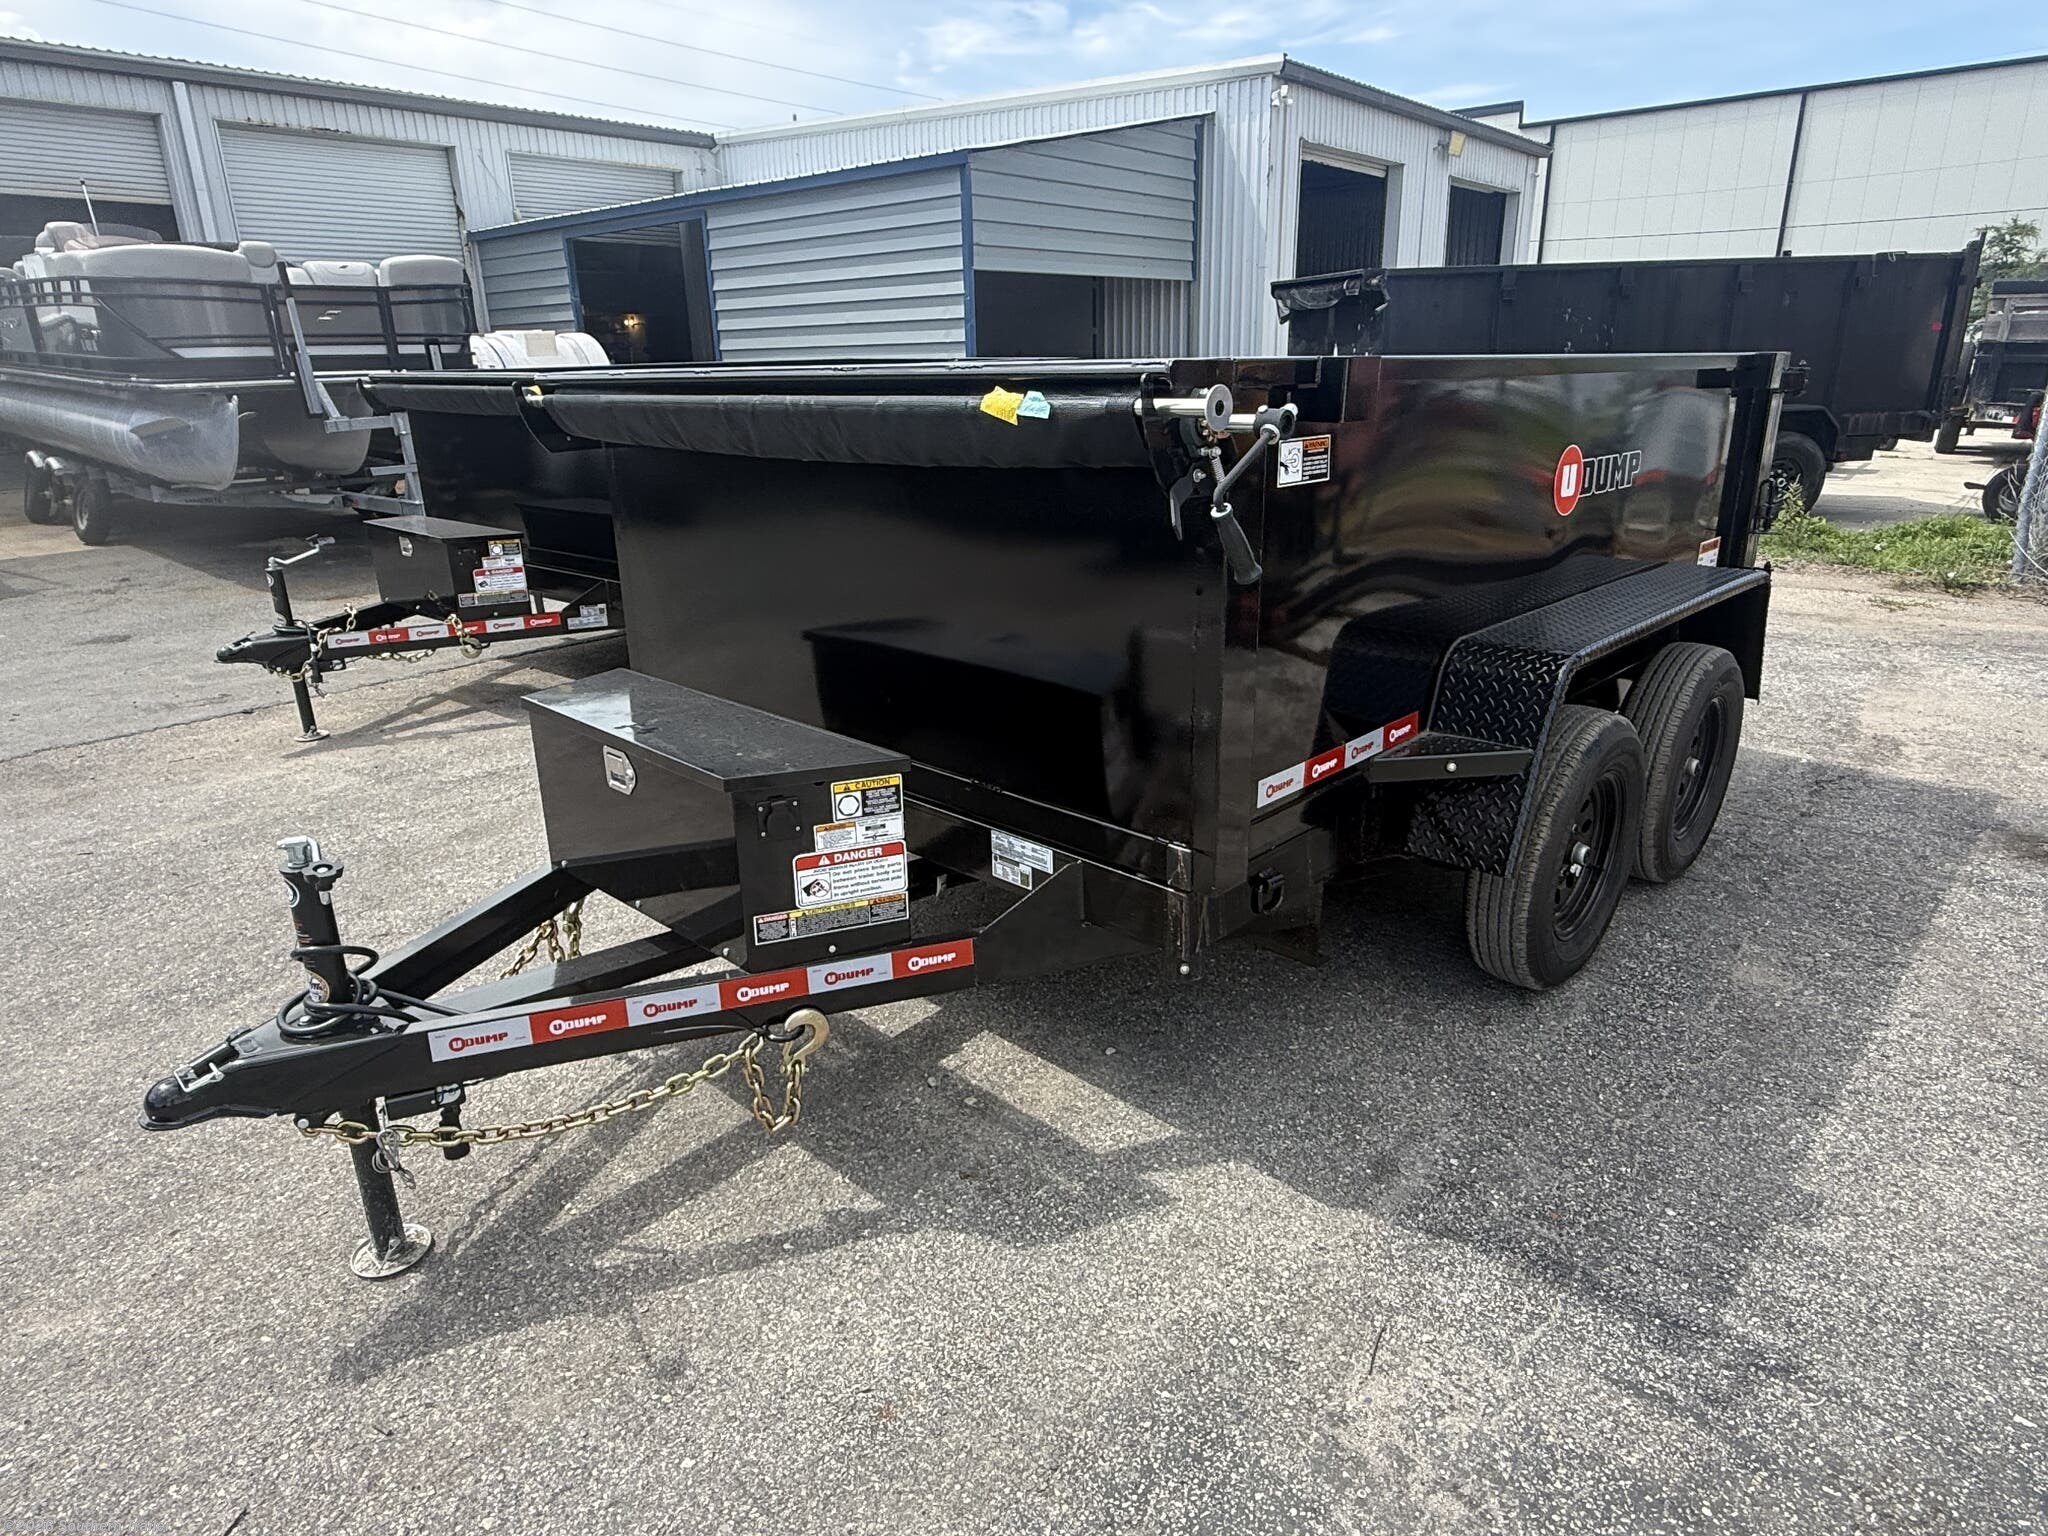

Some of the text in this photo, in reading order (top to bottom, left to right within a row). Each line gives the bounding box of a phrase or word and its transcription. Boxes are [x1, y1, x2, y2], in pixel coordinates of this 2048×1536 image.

[854, 778, 890, 789] CAUTION
[834, 848, 883, 863] DANGER
[448, 952, 956, 1052] UDUMP UDUMP UDUMP UDUMP UDUMP UDUMP
